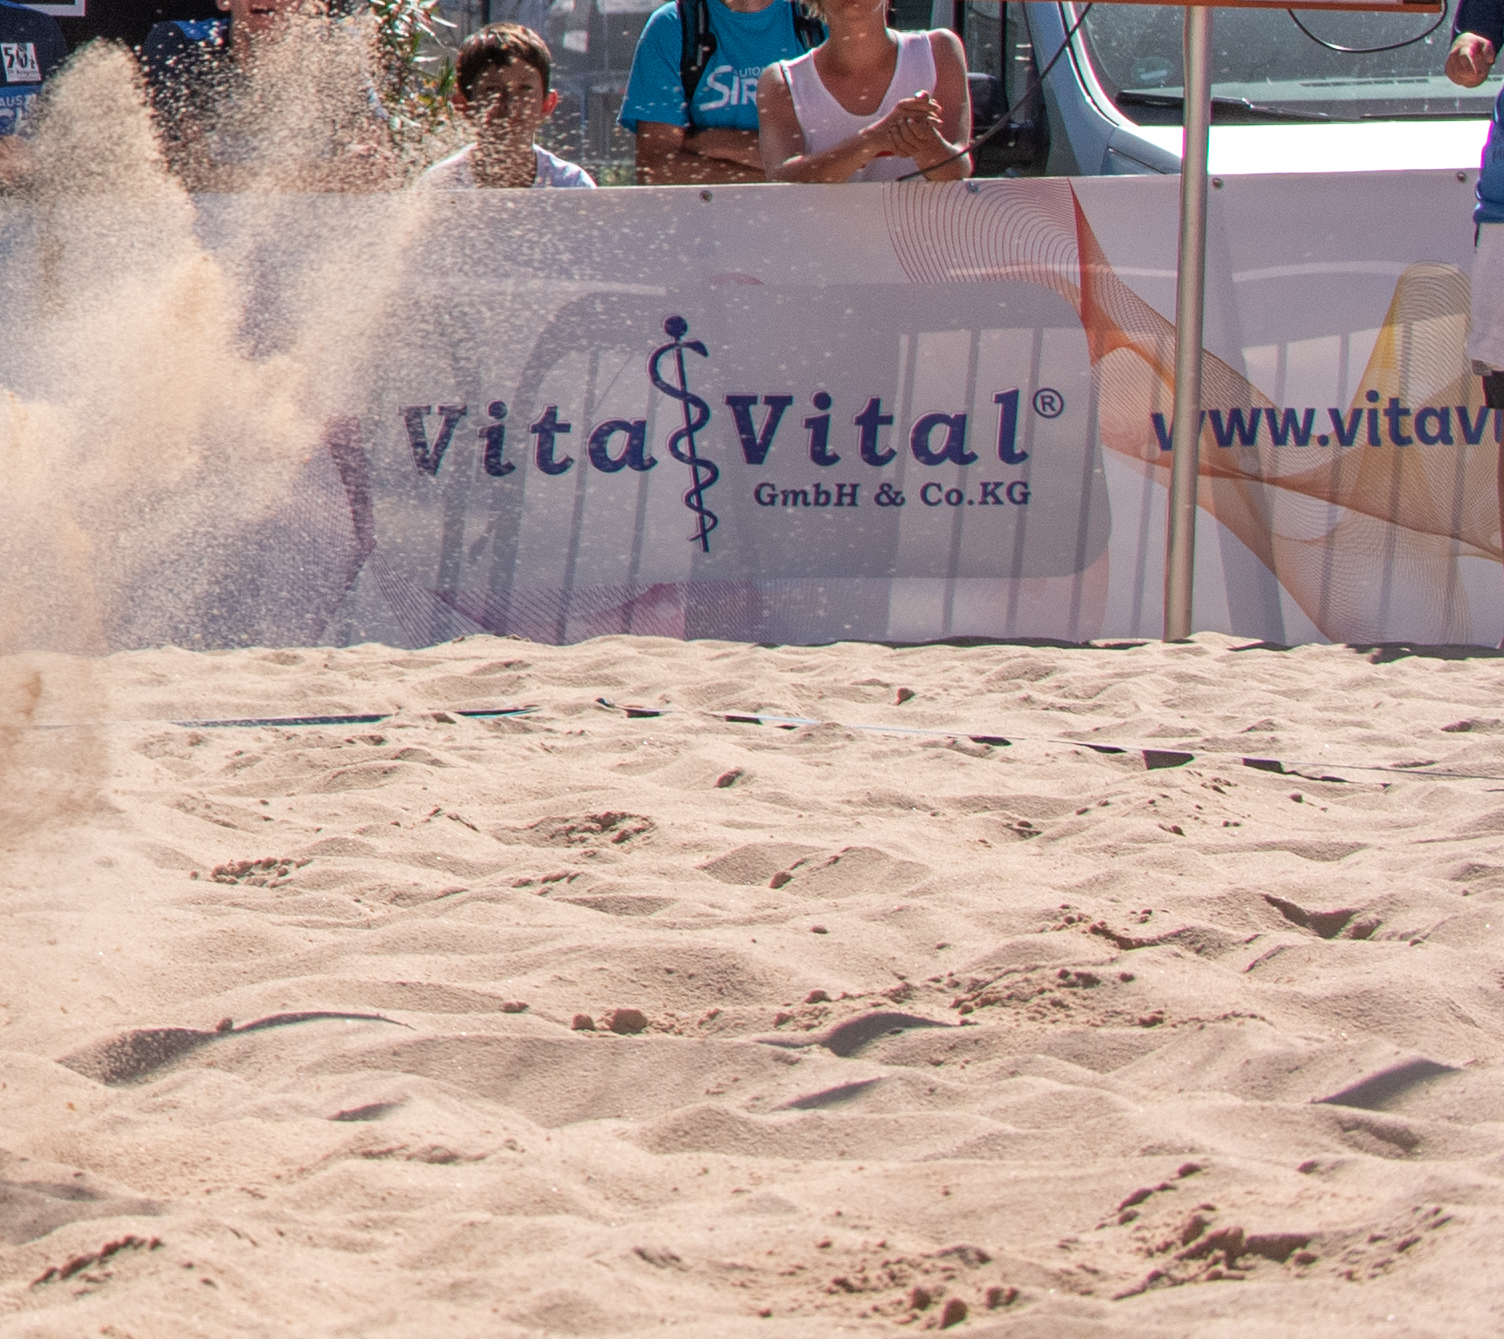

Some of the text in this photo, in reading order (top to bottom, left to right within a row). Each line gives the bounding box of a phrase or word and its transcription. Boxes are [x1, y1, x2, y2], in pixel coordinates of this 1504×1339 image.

[399, 399, 657, 479] Vita
[752, 478, 1032, 511] GmbH & Co.KG
